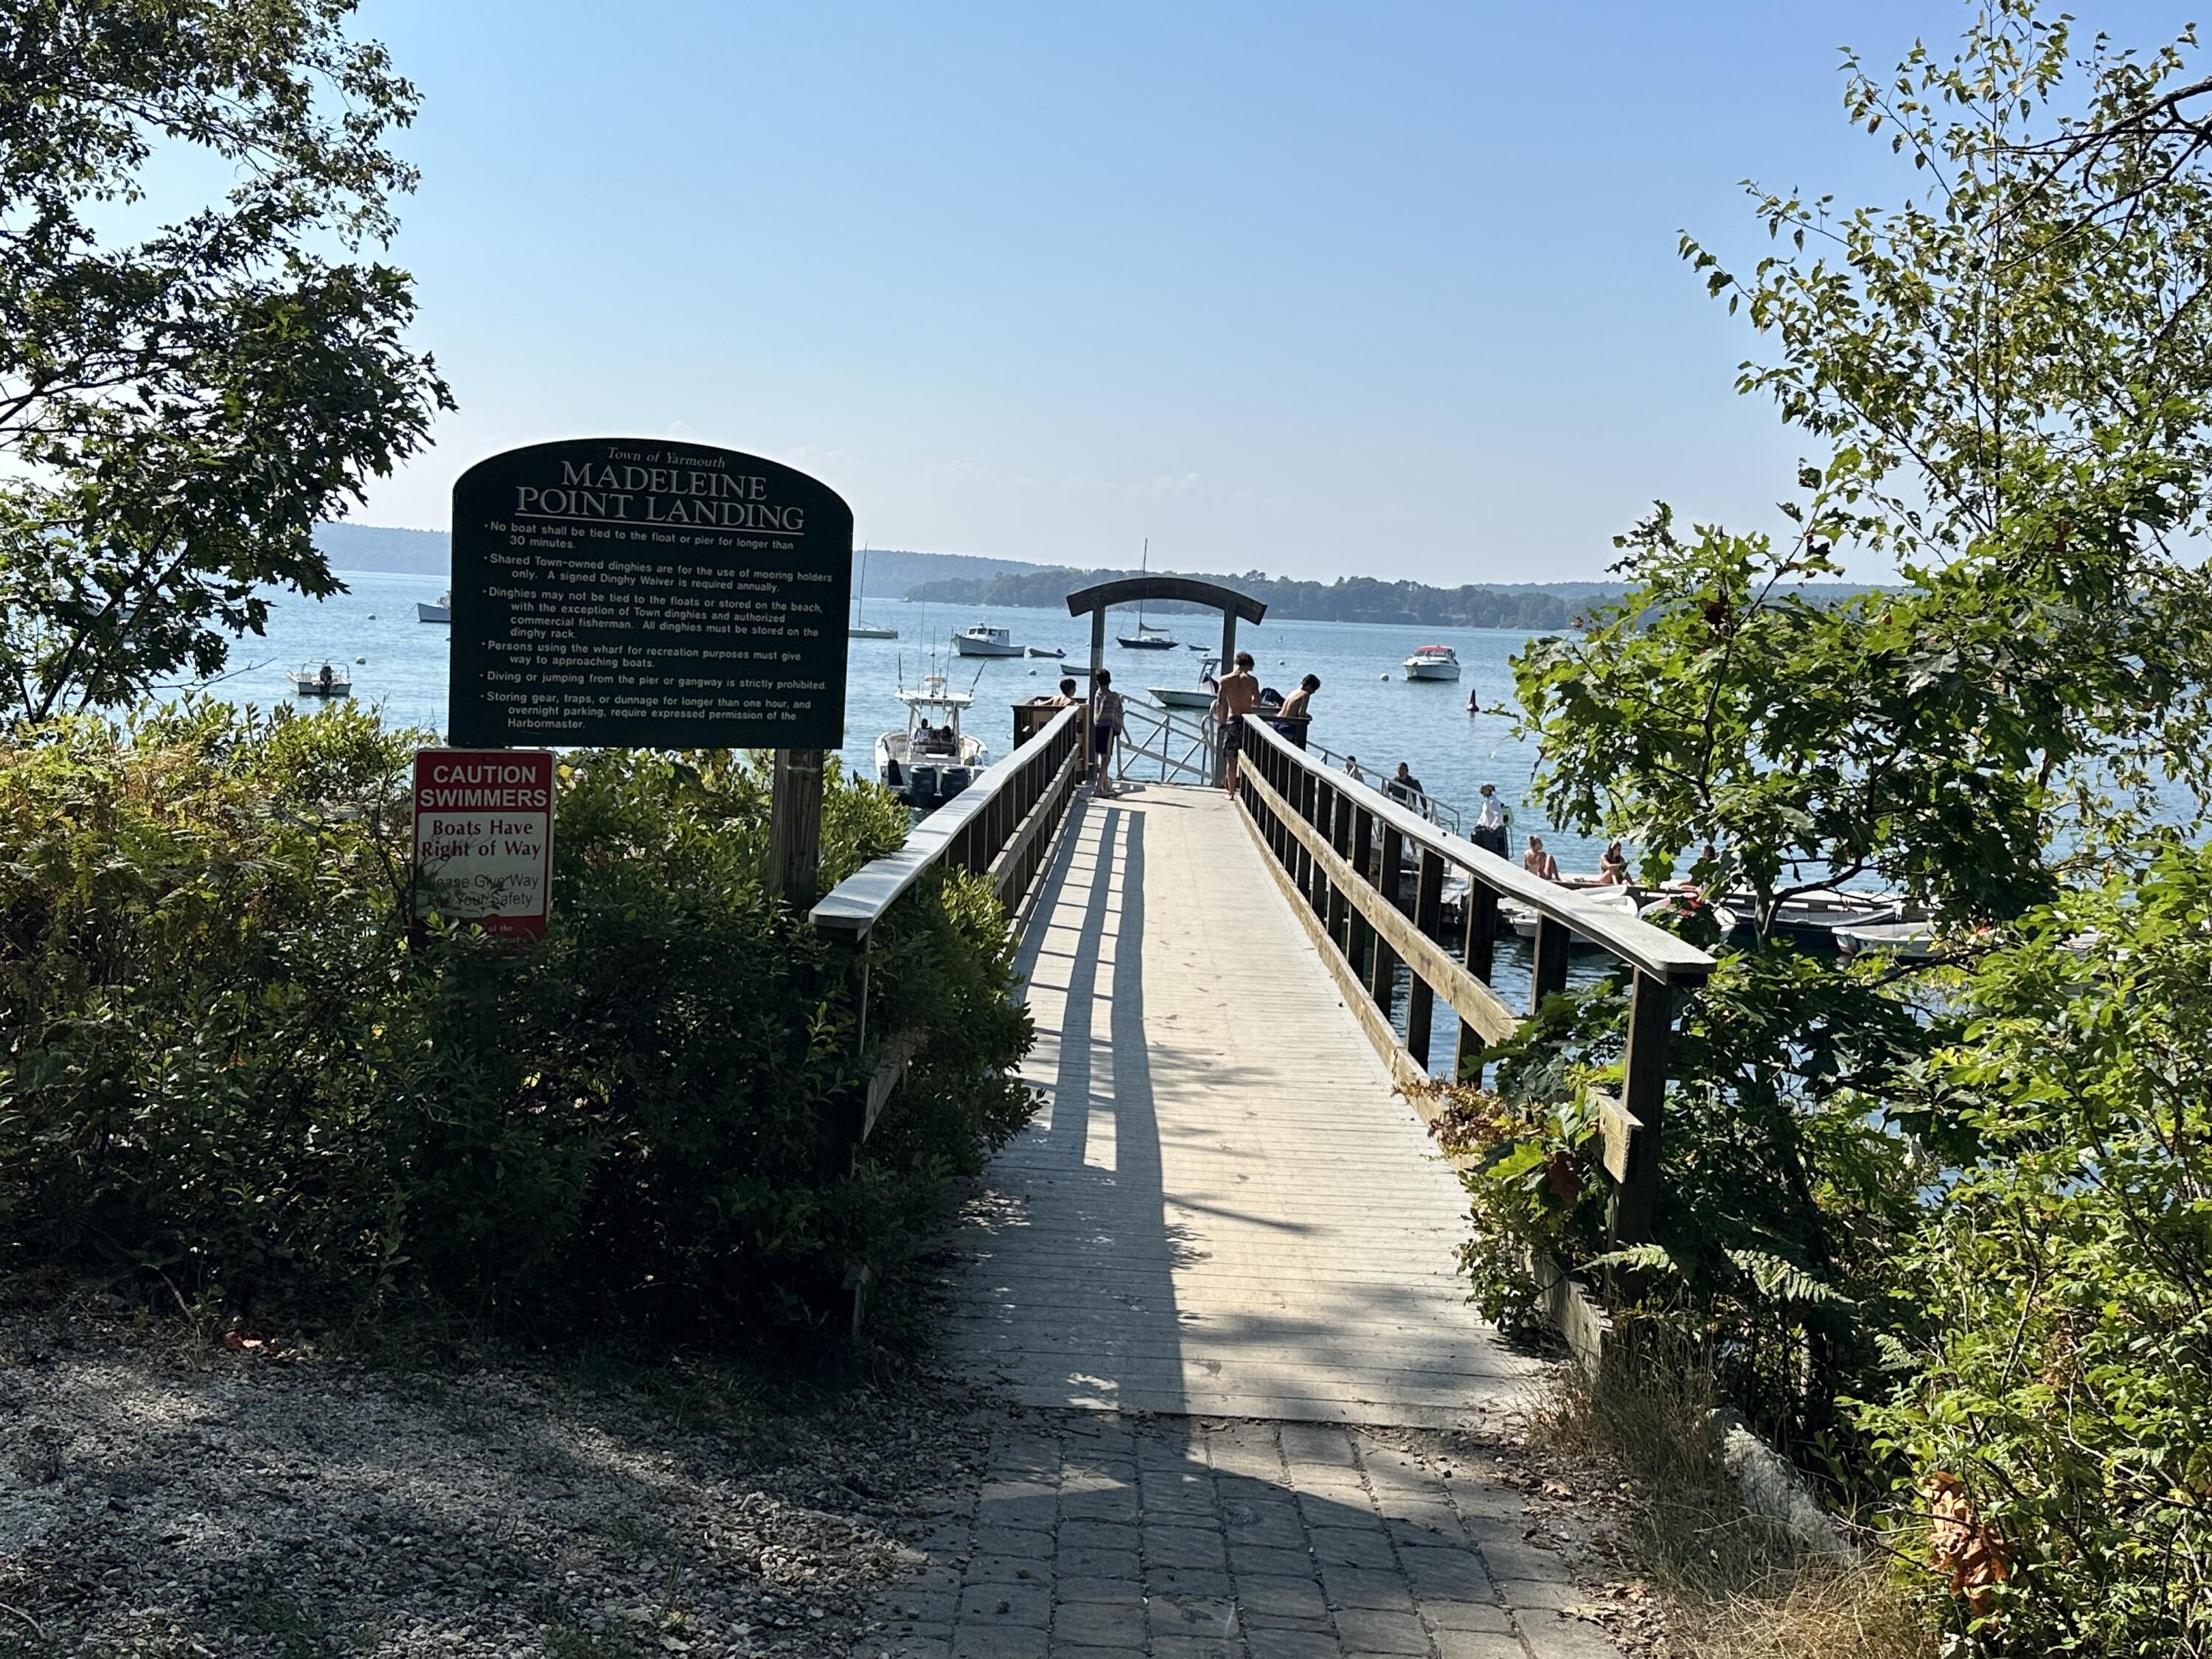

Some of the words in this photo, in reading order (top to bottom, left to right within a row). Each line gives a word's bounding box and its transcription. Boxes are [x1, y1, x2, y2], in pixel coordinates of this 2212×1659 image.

[608, 447, 641, 461] Town
[647, 451, 661, 462] of
[667, 452, 725, 468] Yarmouth
[561, 460, 767, 500] MADELEINE
[515, 485, 633, 518] POINT
[645, 495, 804, 530] LANDING
[490, 521, 507, 532] No
[511, 522, 536, 533] boat
[541, 524, 567, 535] shall
[571, 526, 585, 537] be
[590, 528, 611, 538] tied
[615, 530, 626, 539] to
[630, 531, 647, 540] the
[652, 532, 675, 543] float
[695, 535, 714, 546] pier
[718, 536, 733, 546] for
[737, 538, 768, 549] longer
[772, 540, 793, 550] than
[509, 535, 525, 546] 30
[529, 537, 575, 549] minutes.
[490, 553, 530, 565] Shared
[534, 555, 604, 569] Town-owned
[608, 560, 652, 573] dinghies
[656, 566, 673, 574] are
[678, 565, 692, 574] for
[696, 566, 712, 576] the
[717, 569, 735, 577] use
[739, 568, 750, 577] of
[754, 571, 793, 582] mooring
[797, 571, 832, 582] holders
[512, 568, 538, 580] only.
[547, 570, 555, 580] A
[560, 571, 596, 583] signed
[600, 573, 636, 585] Dinghy
[640, 575, 674, 586] Waiver
[678, 577, 687, 587] is
[692, 580, 733, 590] required
[737, 582, 779, 594] annually.
[489, 586, 537, 599] Dinghies
[541, 591, 564, 601] may
[568, 591, 586, 601] not
[591, 591, 605, 602] be
[609, 593, 630, 602] tied
[634, 594, 645, 603] to
[650, 595, 666, 605] the
[670, 596, 700, 606] floats
[719, 599, 751, 609] stored
[771, 601, 787, 611] the
[790, 602, 822, 613] beach,
[511, 601, 534, 611] with
[539, 602, 556, 613] the
[561, 605, 614, 616] exception
[619, 606, 630, 616] of
[633, 606, 660, 617] Town
[664, 608, 707, 621] dinghies
[711, 611, 730, 620] and
[734, 612, 785, 623] authorized
[510, 616, 574, 626] commercial
[579, 617, 633, 629] fisherman.
[642, 620, 655, 630] All
[659, 621, 702, 633] dinghies
[706, 625, 731, 633] must
[734, 625, 748, 634] be
[751, 626, 783, 635] stored
[803, 627, 818, 637] the
[510, 627, 546, 639] dinghy
[551, 629, 577, 639] rack.
[488, 640, 532, 651] Persons
[538, 642, 566, 655] using
[571, 643, 588, 653] the
[593, 644, 623, 654] wharf
[627, 645, 642, 655] for
[646, 647, 699, 657] recreation
[703, 650, 749, 659] purposes
[753, 651, 777, 660] must
[781, 651, 801, 662] give
[509, 655, 532, 665] way
[536, 655, 548, 664] to
[552, 656, 618, 669] approaching
[622, 657, 655, 668] boats.
[487, 670, 521, 684] Diving
[526, 673, 538, 681] or
[541, 672, 584, 684] jumping
[589, 673, 613, 684] from
[618, 675, 635, 684] the
[639, 675, 659, 686] pier
[678, 678, 723, 688] gangway
[726, 679, 735, 687] is
[739, 678, 773, 689] strictly
[776, 680, 827, 690] prohibited.
[487, 691, 527, 703] Storing
[532, 694, 559, 704] gear,
[564, 694, 594, 705] traps,
[614, 695, 658, 706] dunnage
[663, 695, 678, 705] for
[681, 696, 714, 708] longer
[717, 698, 740, 706] than
[743, 700, 762, 708] one
[765, 699, 789, 709] hour,
[793, 700, 811, 709] and
[508, 705, 559, 717] overnight
[563, 706, 606, 718] parking,
[611, 708, 647, 718] require
[651, 709, 705, 719] expressed
[709, 710, 763, 720] permission
[767, 711, 777, 720] of
[781, 711, 796, 720] the
[507, 717, 585, 728] Harbormaster.
[433, 765, 536, 784] CAUTION
[420, 789, 547, 807] SWIMMERS
[433, 820, 481, 835] Boats
[490, 819, 533, 835] Have
[422, 841, 470, 860] Right
[479, 841, 496, 856] of
[504, 841, 542, 860] Way
[509, 874, 539, 889] Way
[490, 891, 533, 908] Safety
[487, 924, 497, 933] of
[500, 924, 514, 933] the
